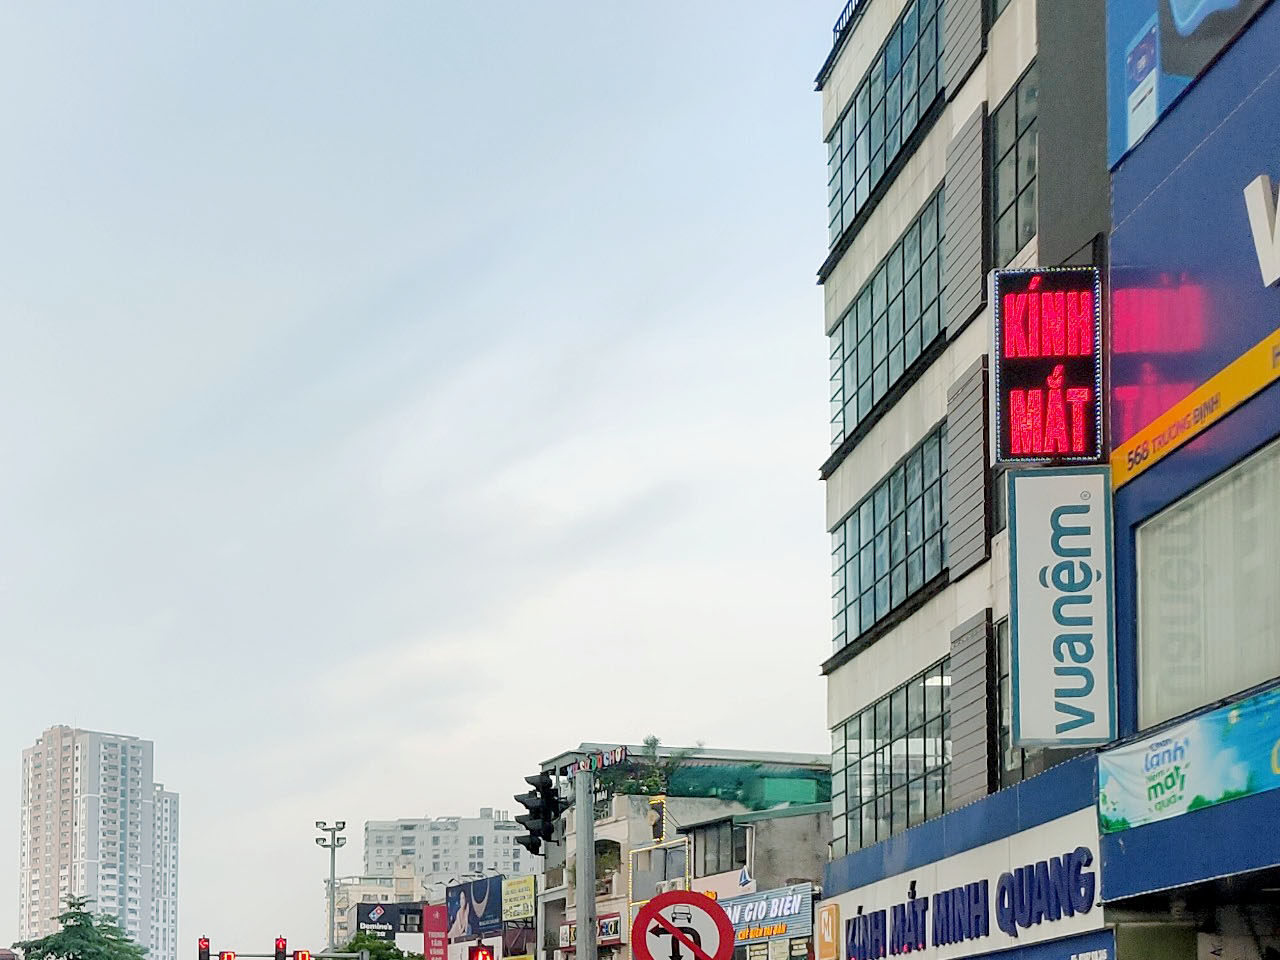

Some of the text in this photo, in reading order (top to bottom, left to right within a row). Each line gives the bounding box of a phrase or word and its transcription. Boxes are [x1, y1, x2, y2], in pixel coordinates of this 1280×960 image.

[1004, 276, 1093, 358] KÍNH
[1010, 364, 1091, 454] MẮT
[1127, 439, 1149, 471] 568
[889, 880, 929, 957] MẮT
[931, 879, 990, 948] MINH
[995, 846, 1096, 938] QUANG
